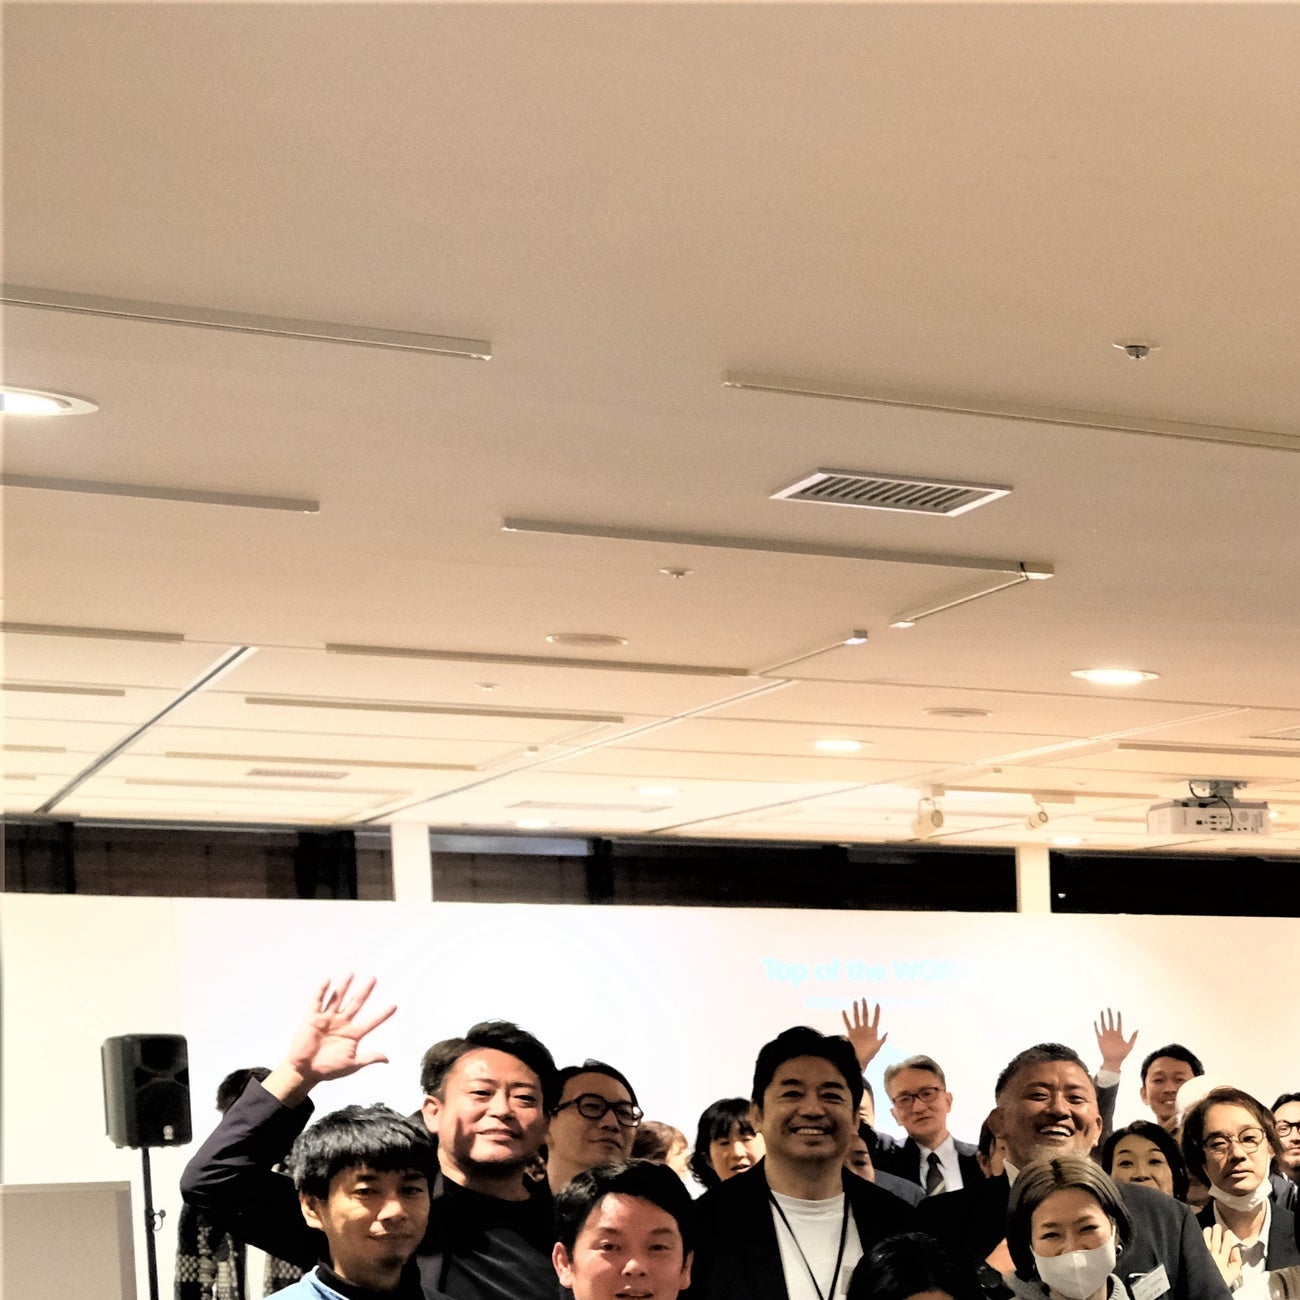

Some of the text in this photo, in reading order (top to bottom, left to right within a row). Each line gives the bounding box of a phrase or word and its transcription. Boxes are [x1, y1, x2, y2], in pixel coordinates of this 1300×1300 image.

[761, 958, 808, 986] Top
[814, 957, 841, 981] of
[847, 959, 887, 981] the
